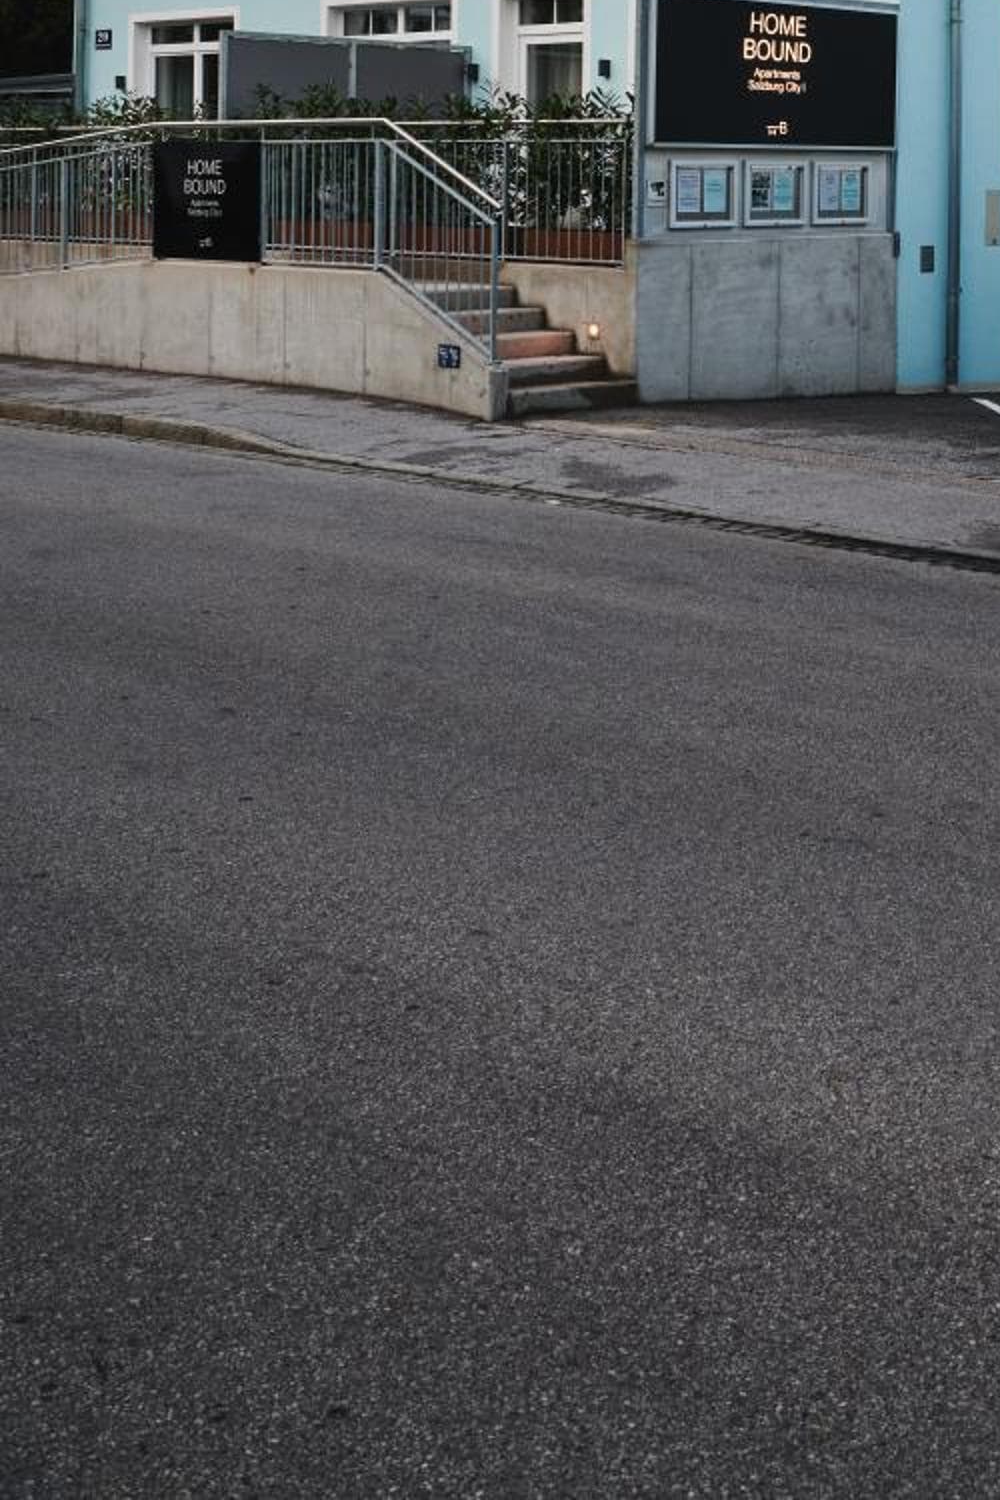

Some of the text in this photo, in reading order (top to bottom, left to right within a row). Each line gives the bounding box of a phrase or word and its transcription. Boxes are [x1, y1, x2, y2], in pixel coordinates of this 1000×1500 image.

[749, 11, 807, 37] HOME
[743, 37, 812, 63] BOUND
[187, 159, 223, 175] HOME
[183, 179, 227, 195] BOUND
